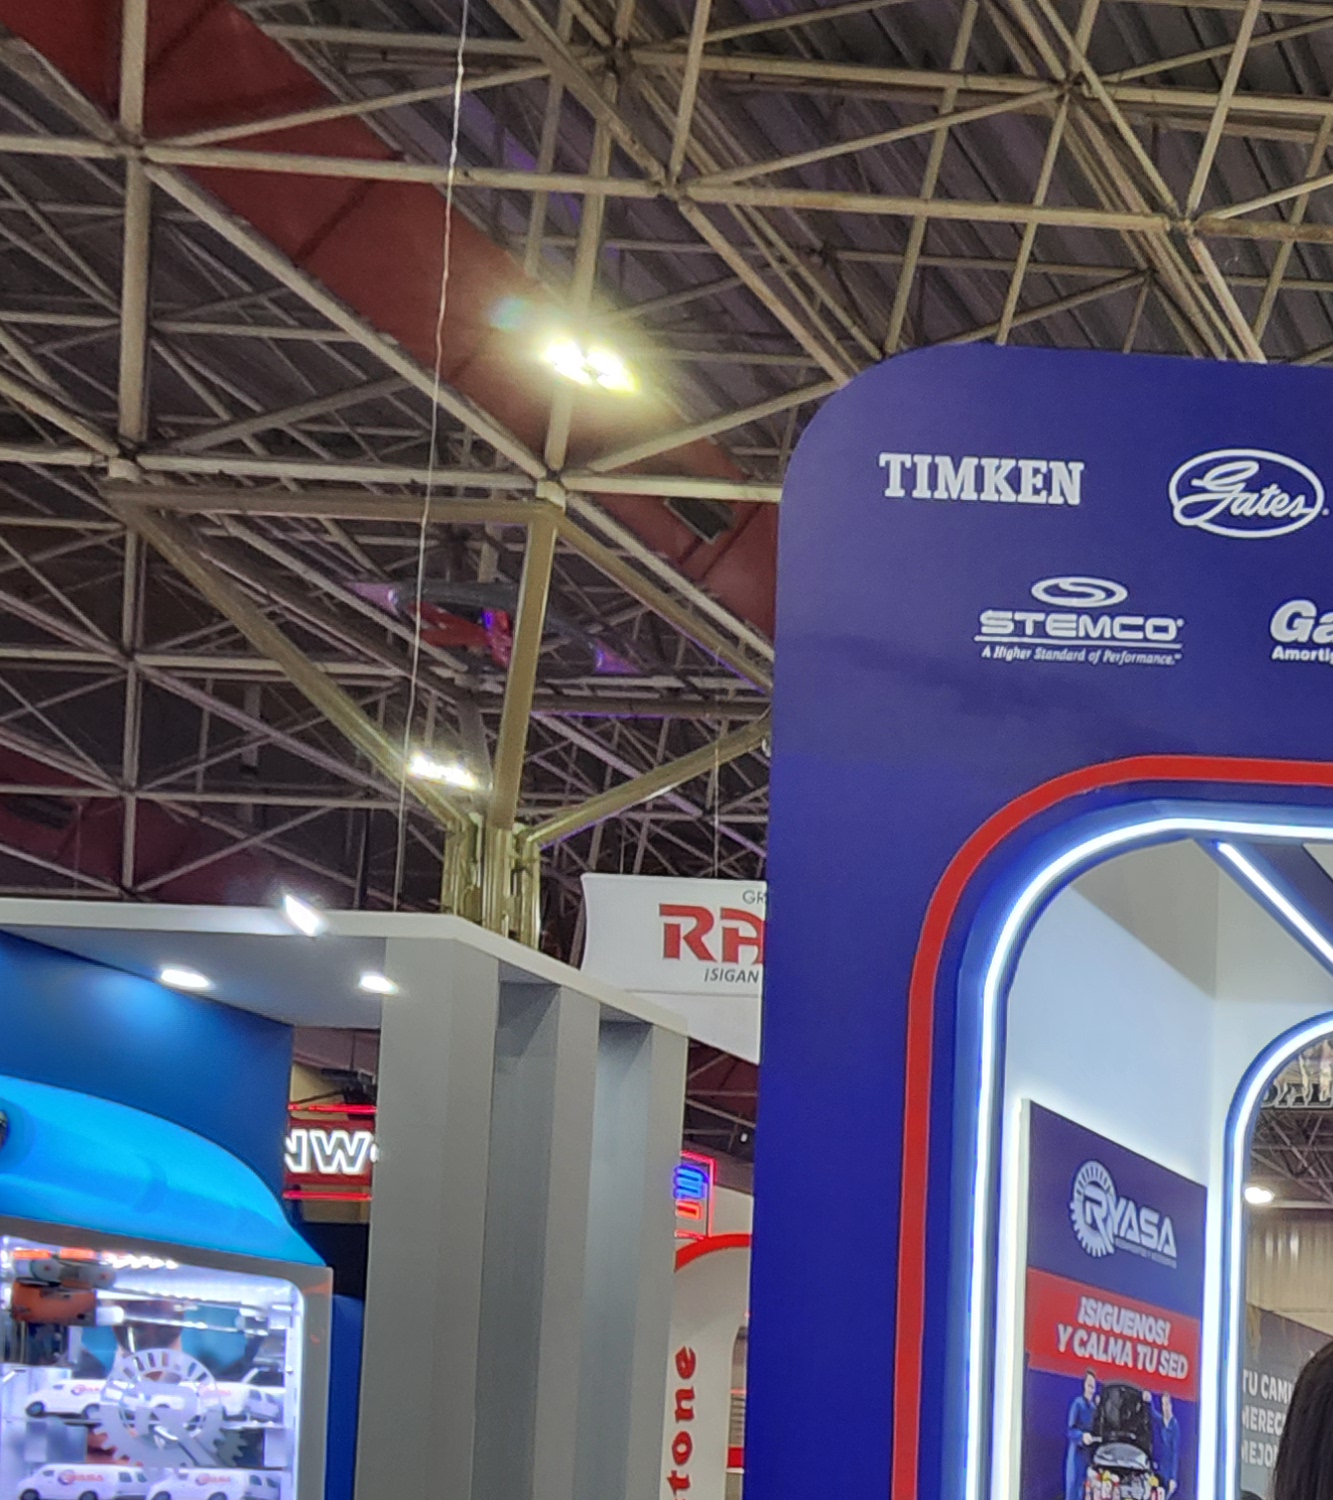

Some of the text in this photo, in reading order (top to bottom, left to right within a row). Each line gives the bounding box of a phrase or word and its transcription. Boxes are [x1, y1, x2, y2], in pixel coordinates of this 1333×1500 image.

[879, 452, 1085, 505] TIMKEN
[1174, 460, 1316, 526] Gates
[980, 610, 1177, 640] STEMCO
[982, 645, 991, 658] A
[994, 646, 1031, 661] Higher
[1034, 648, 1085, 661] Standard
[1088, 650, 1100, 665] of
[1083, 1182, 1177, 1257] RYASA
[1058, 1323, 1189, 1380] Y CALMA TU SED
